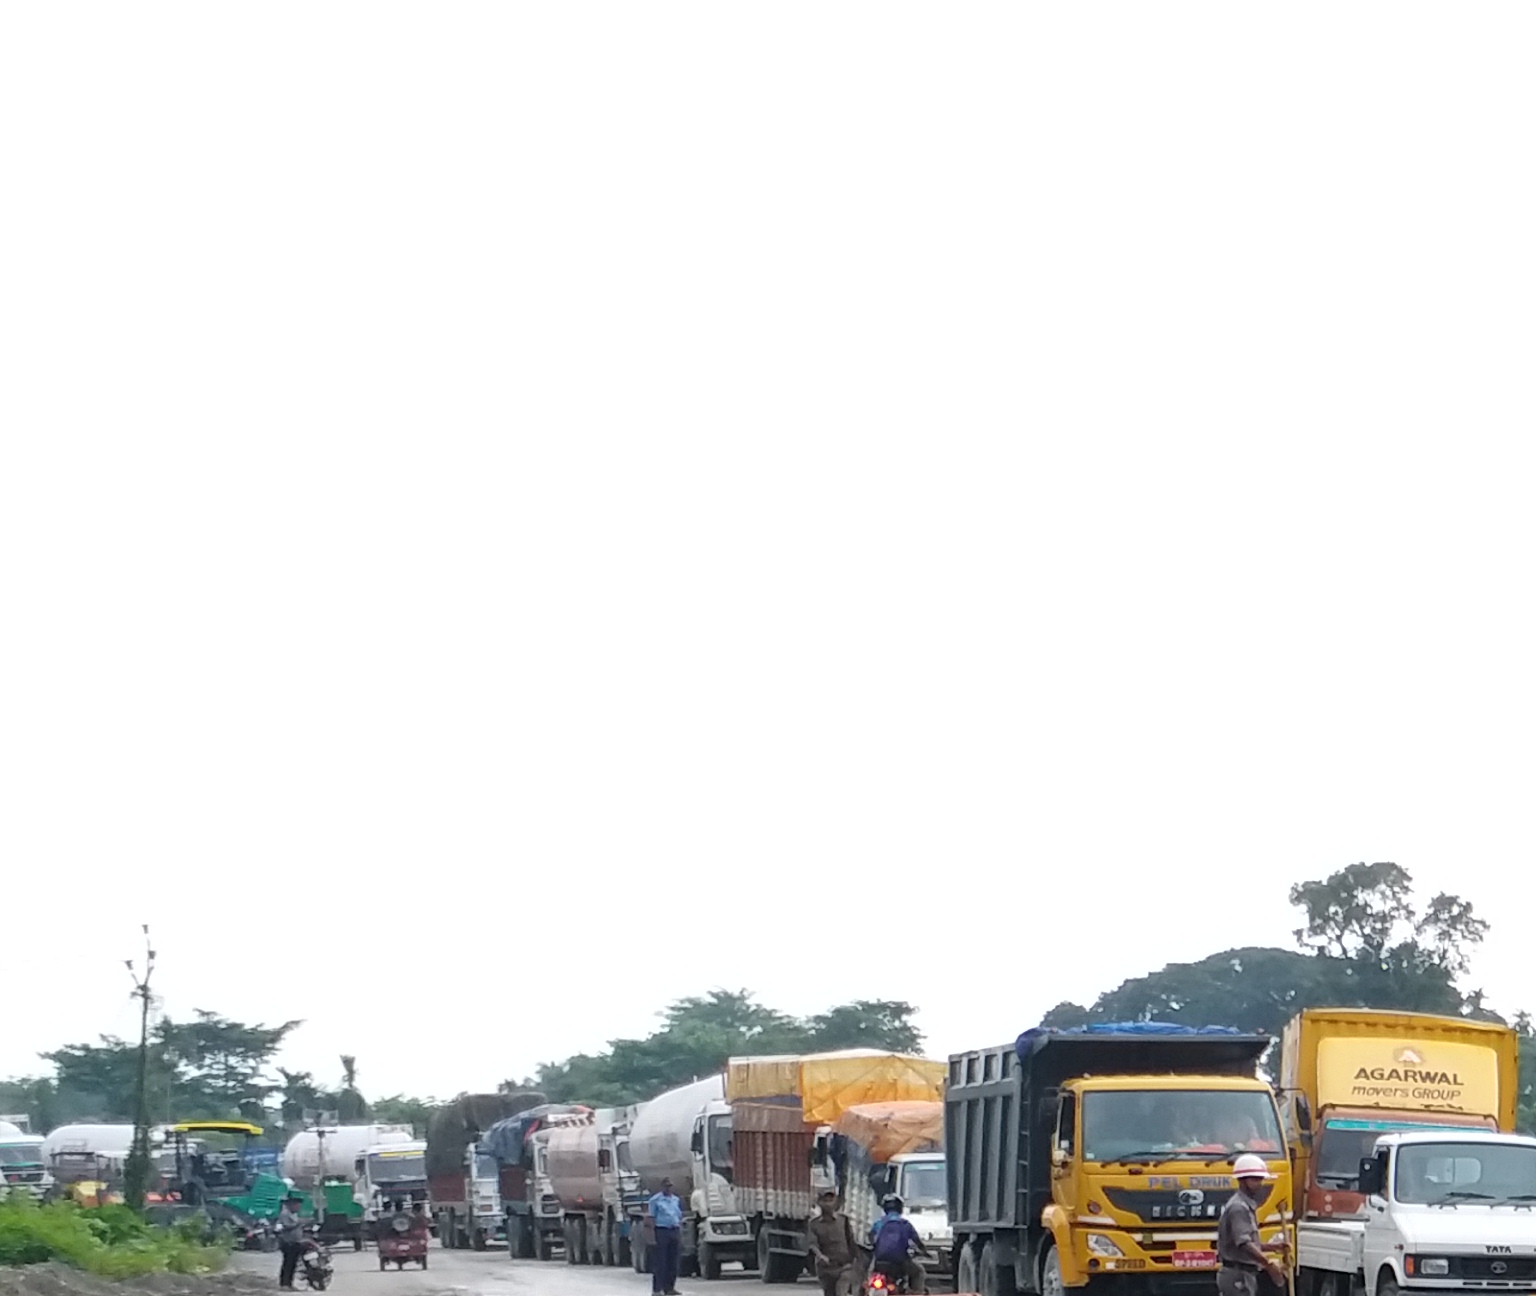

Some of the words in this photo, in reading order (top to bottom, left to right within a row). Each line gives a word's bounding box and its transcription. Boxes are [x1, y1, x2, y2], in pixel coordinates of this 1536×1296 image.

[1354, 1067, 1464, 1086] AGARWAL
[1352, 1085, 1409, 1098] movers
[1411, 1087, 1461, 1100] GROUP
[1152, 1205, 1226, 1218] EICHE
[1485, 1245, 1512, 1254] TATA
